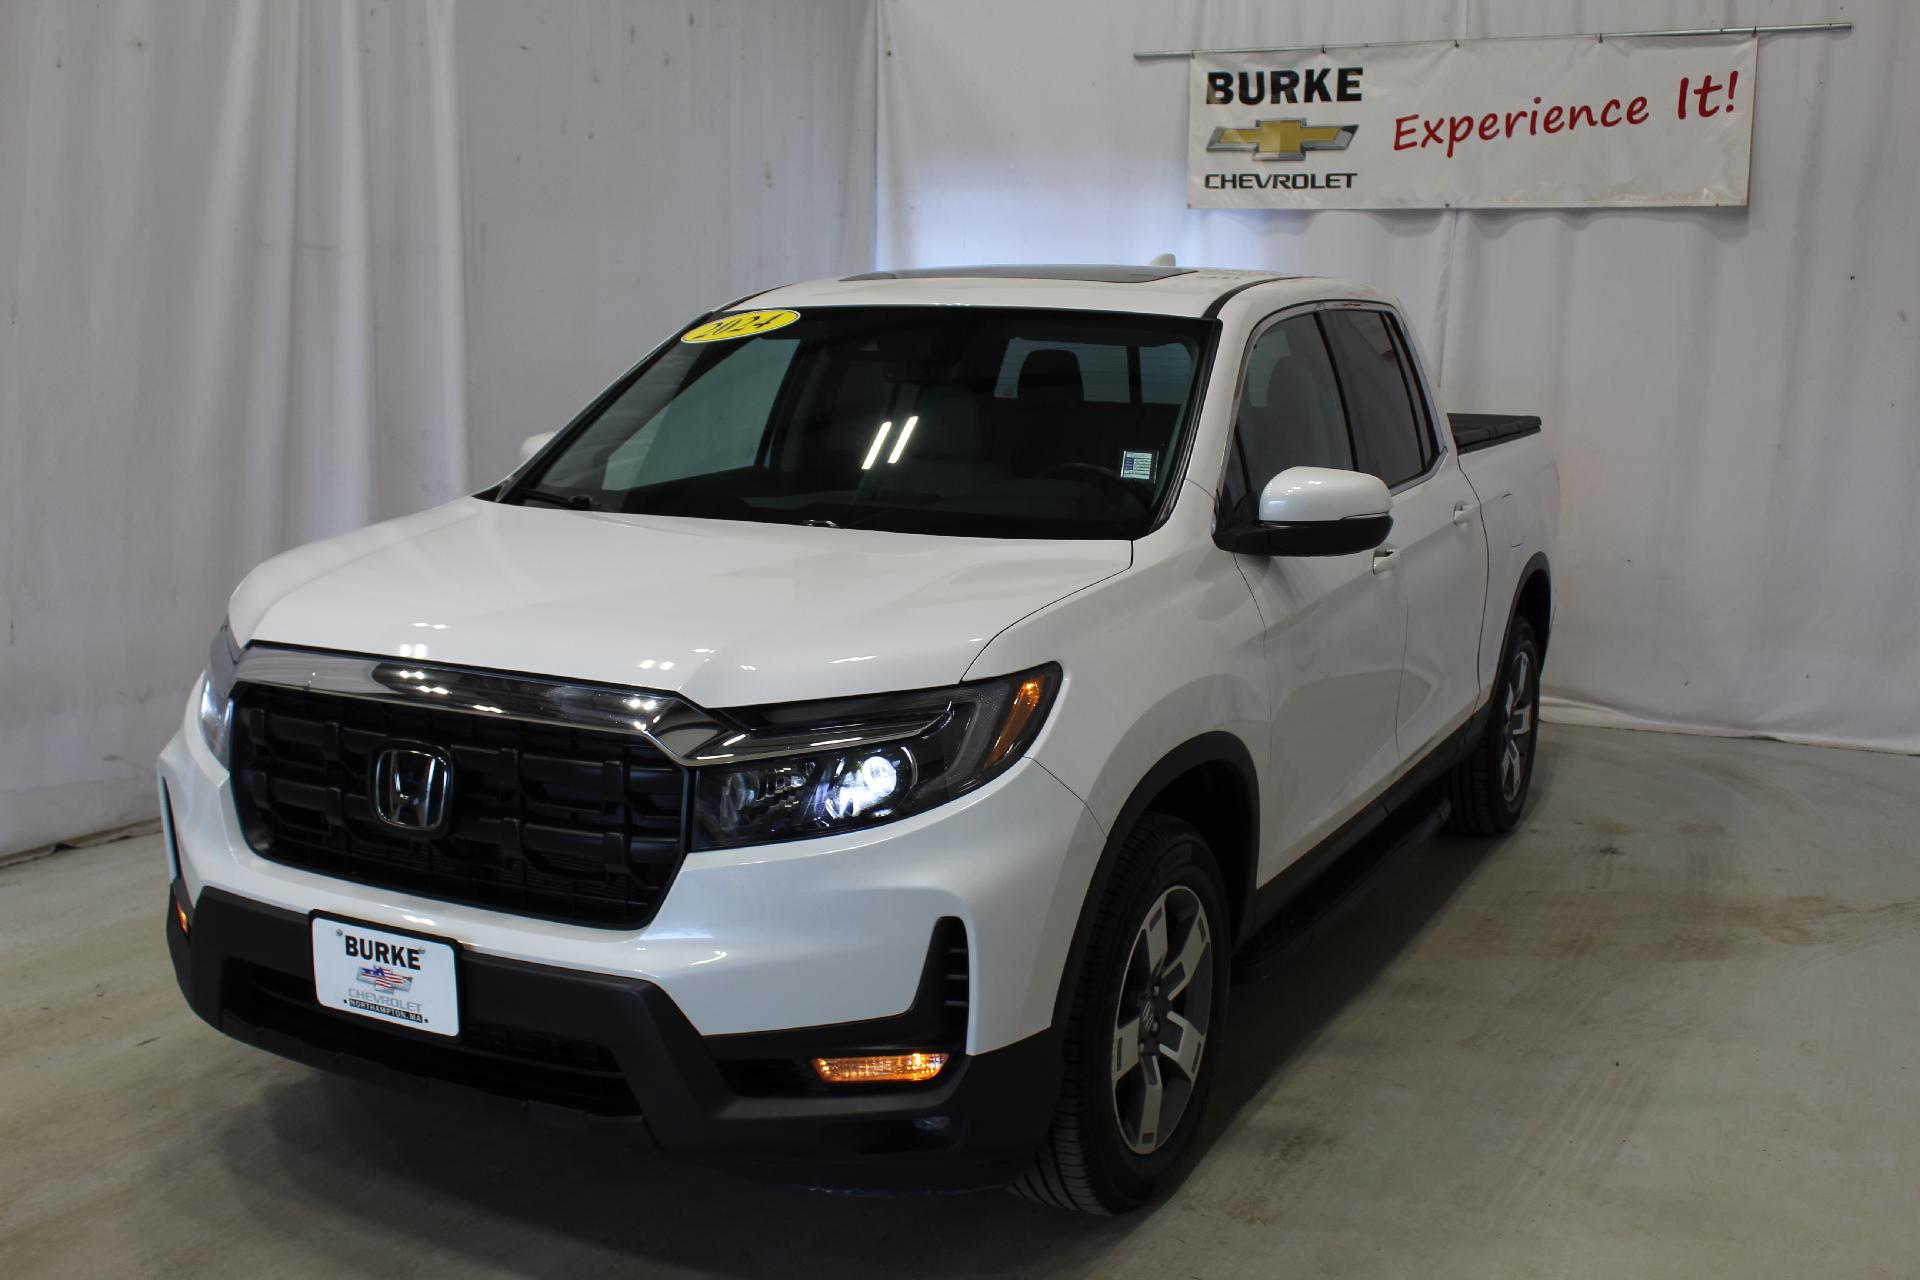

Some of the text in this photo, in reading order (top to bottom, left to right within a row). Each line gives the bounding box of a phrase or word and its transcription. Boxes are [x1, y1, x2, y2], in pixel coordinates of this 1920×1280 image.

[1206, 67, 1364, 105] BURKE
[1393, 70, 1740, 157] Experience It!
[1204, 172, 1358, 190] CHEVROLET
[692, 312, 785, 340] 2024
[345, 935, 421, 970] BURKE
[348, 988, 423, 1013] CHEVROLET
[409, 1012, 422, 1023] MA
